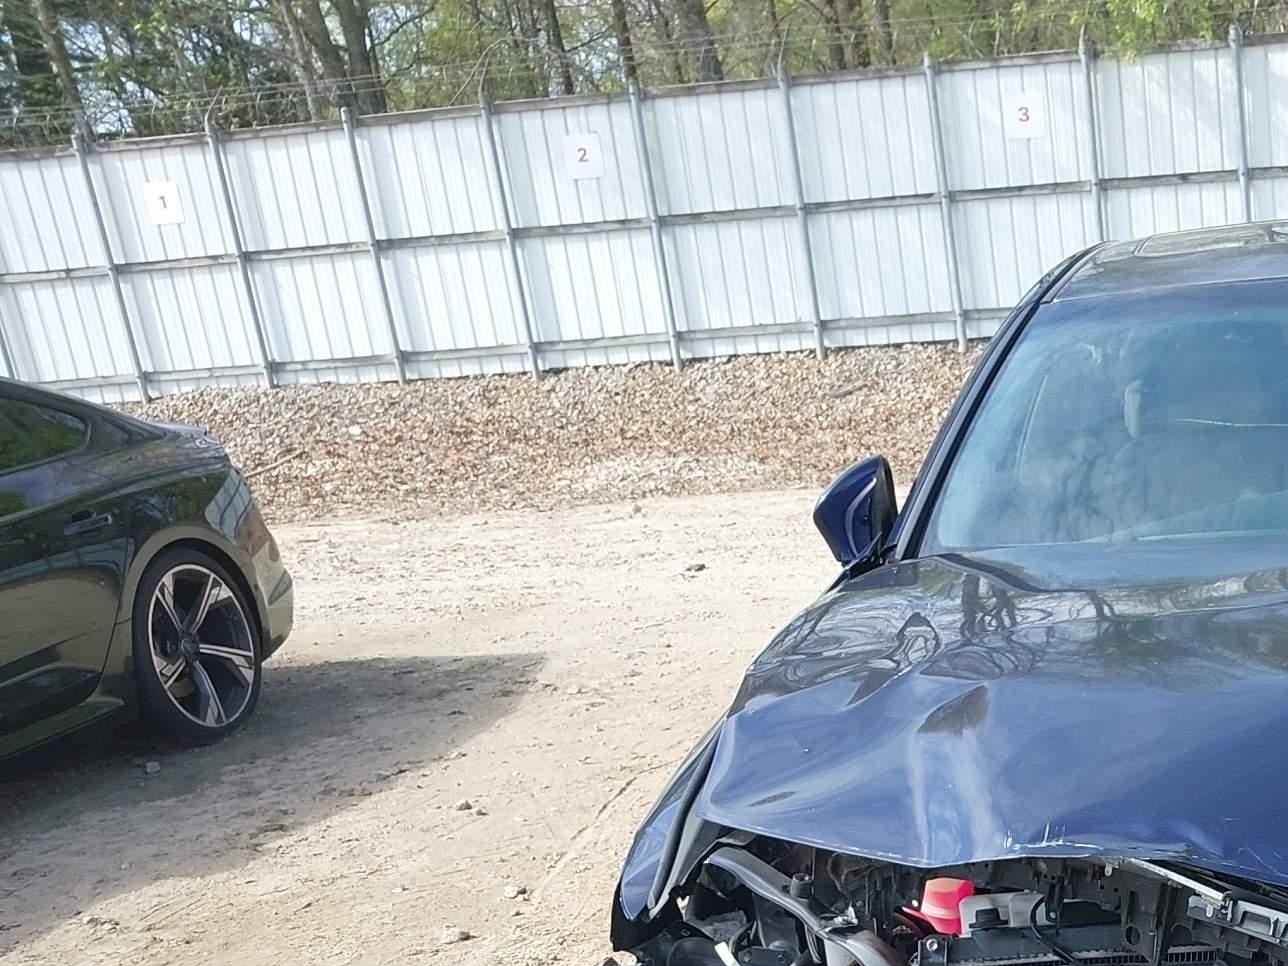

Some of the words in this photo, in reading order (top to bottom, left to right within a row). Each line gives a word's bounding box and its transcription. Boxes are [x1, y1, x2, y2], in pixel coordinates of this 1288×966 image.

[1018, 107, 1030, 122] 3
[577, 148, 589, 162] 2
[158, 196, 167, 209] 1
